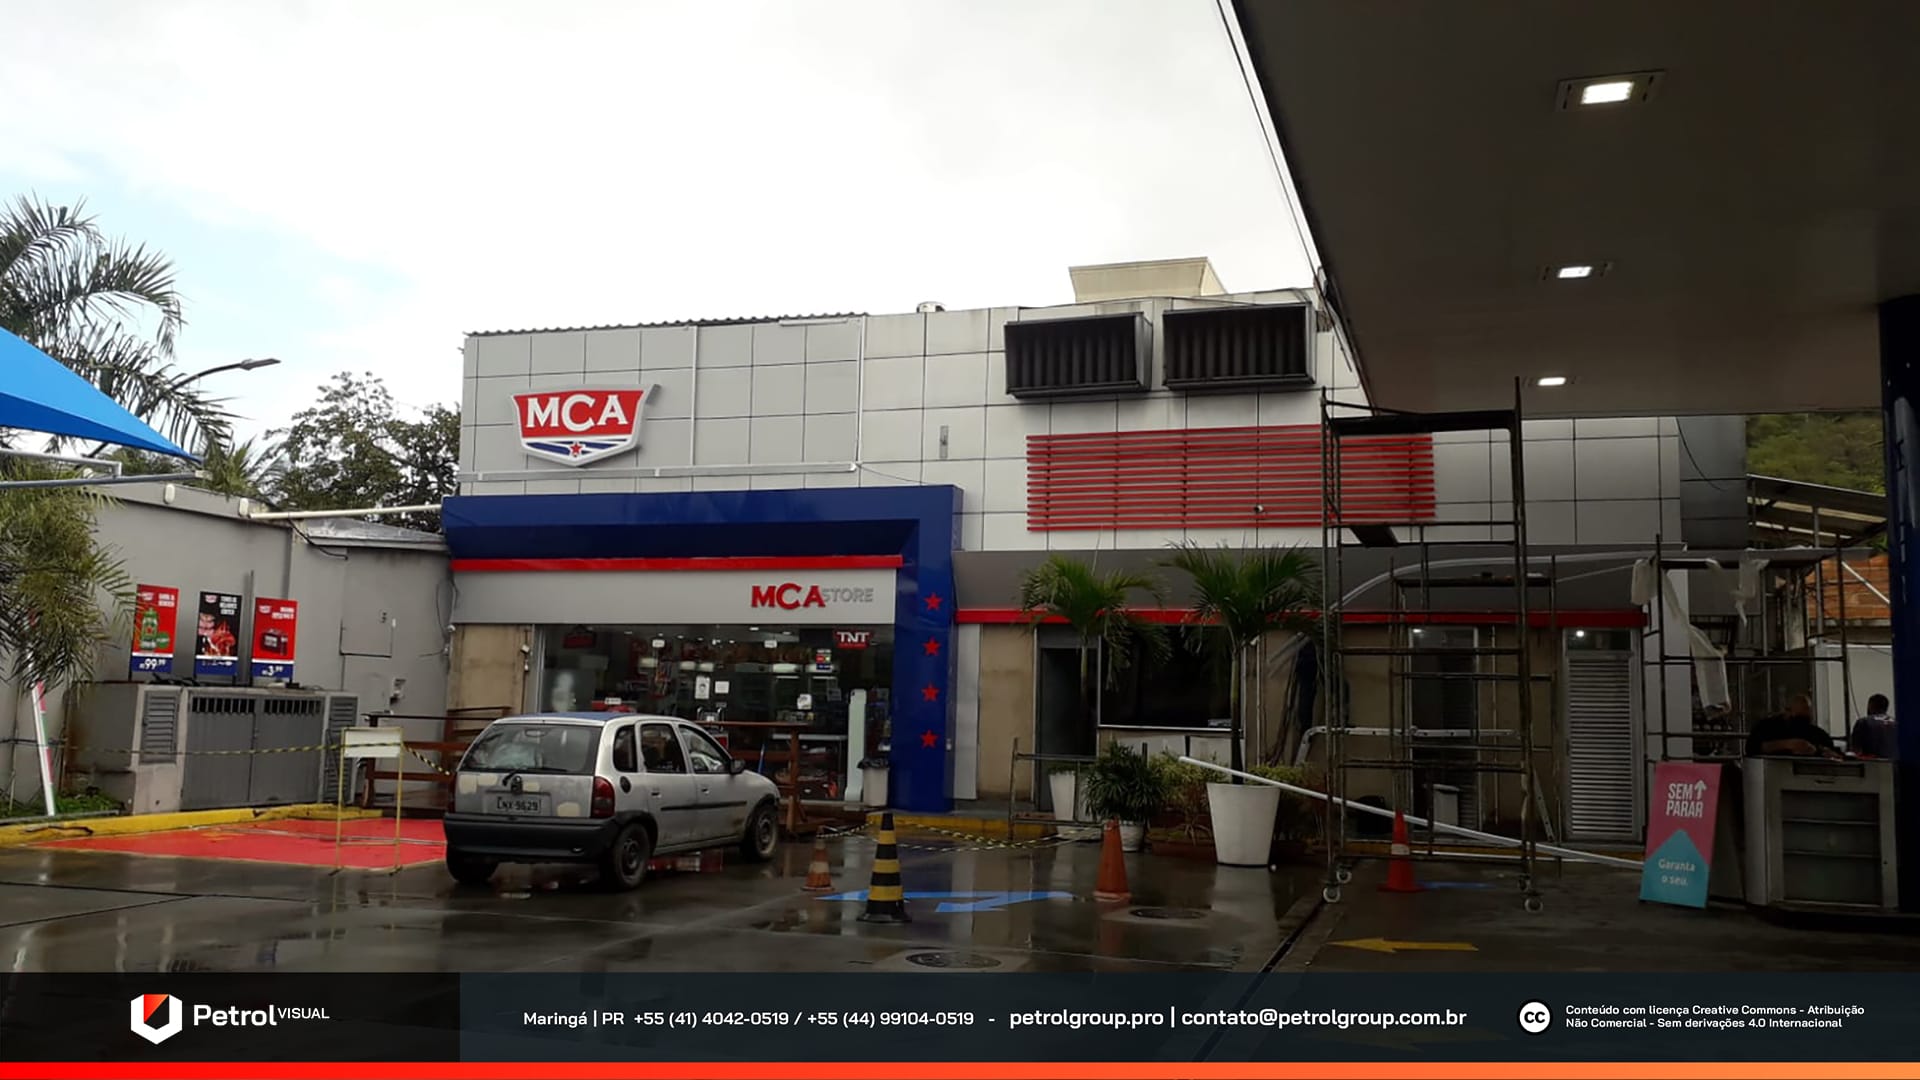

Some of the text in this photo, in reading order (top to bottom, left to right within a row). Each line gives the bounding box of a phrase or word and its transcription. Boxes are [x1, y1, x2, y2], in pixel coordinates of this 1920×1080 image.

[526, 394, 629, 432] MCA
[751, 583, 874, 610] MCA STORE
[837, 631, 870, 643] TNT
[1667, 783, 1693, 800] SEM
[1665, 800, 1704, 818] PARAR
[1658, 858, 1696, 872] Garanta
